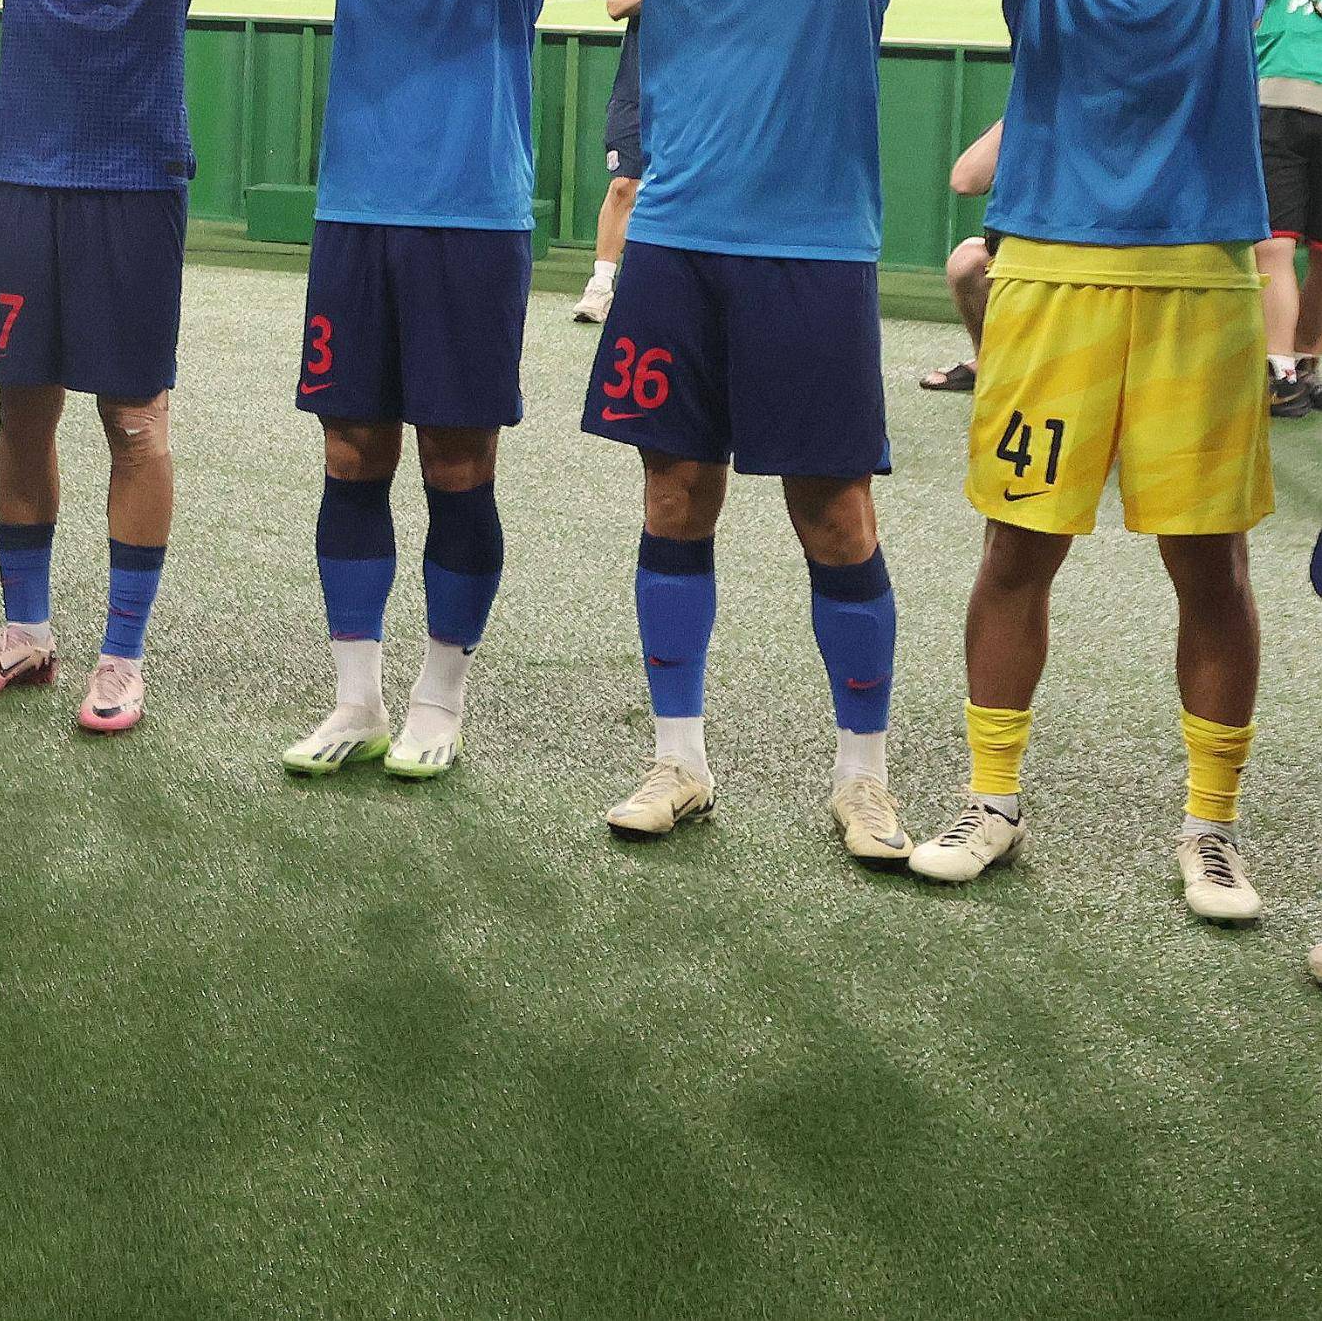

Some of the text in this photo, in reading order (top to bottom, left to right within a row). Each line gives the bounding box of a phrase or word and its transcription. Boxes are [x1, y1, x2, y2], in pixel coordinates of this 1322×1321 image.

[307, 315, 332, 374] 3
[602, 337, 673, 410] 36
[997, 410, 1063, 485] 41
